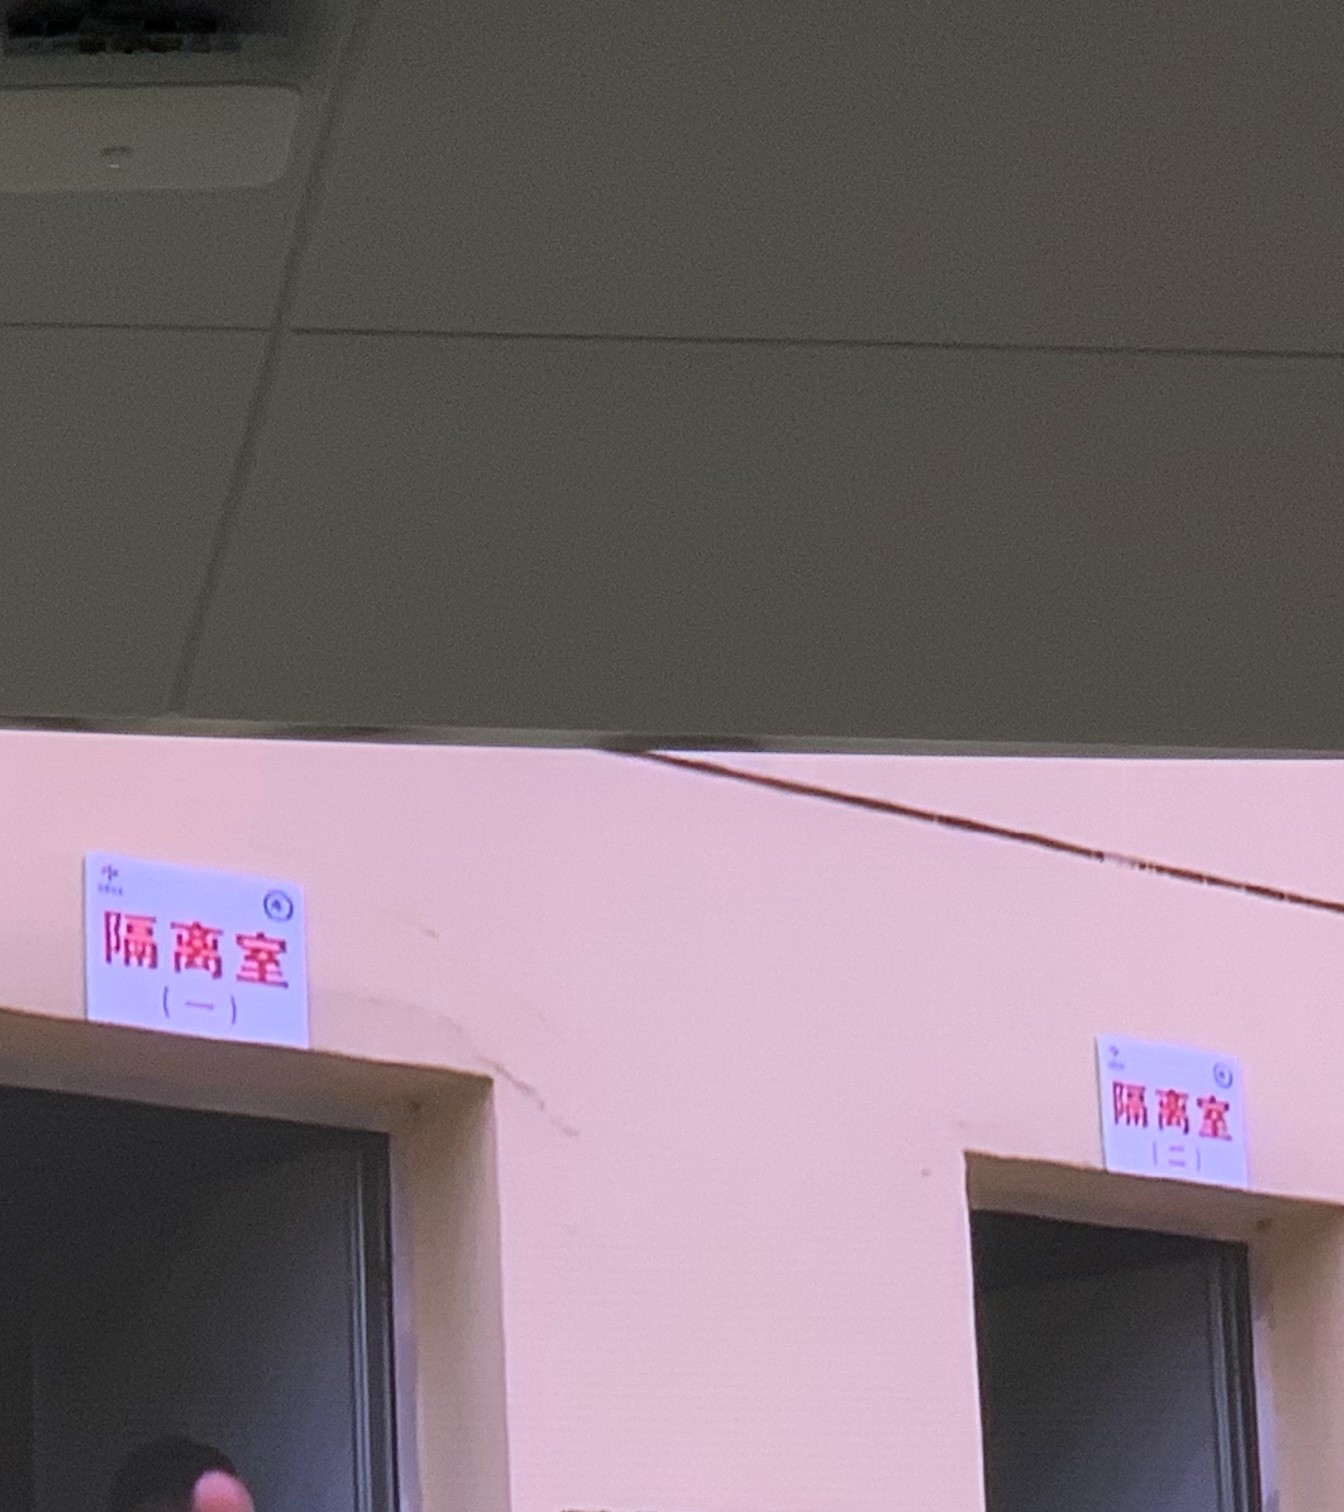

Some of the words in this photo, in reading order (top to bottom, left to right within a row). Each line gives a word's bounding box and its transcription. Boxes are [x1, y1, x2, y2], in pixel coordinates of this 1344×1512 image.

[104, 911, 289, 988] 隔离室
[1112, 1080, 1232, 1142] 隔离室
